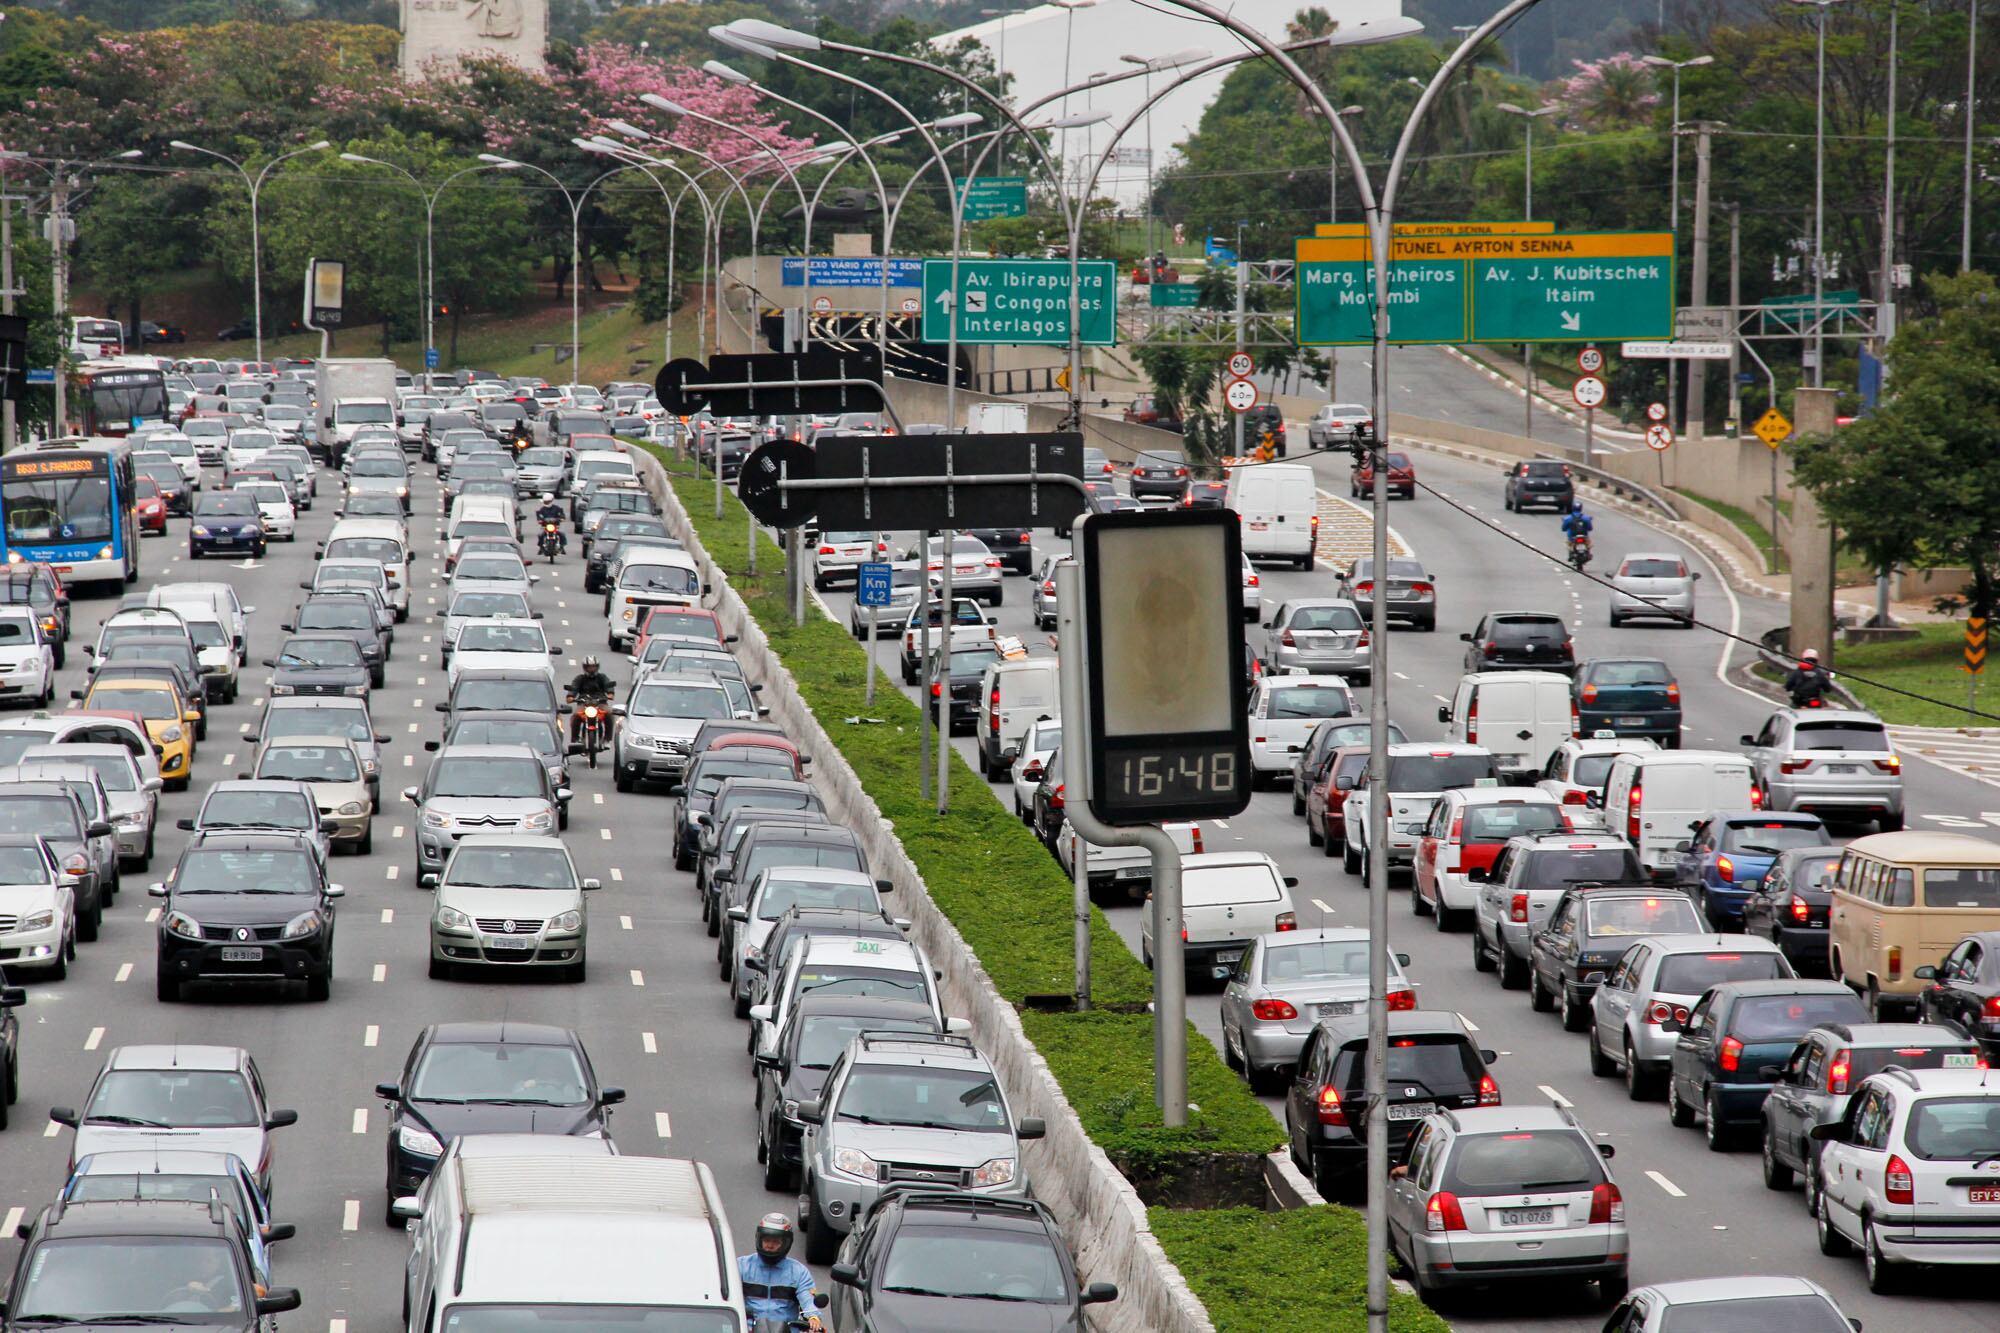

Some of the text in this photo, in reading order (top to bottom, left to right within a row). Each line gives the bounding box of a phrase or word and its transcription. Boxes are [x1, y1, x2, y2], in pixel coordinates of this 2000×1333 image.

[1415, 226, 1454, 234] AYRTON
[1458, 226, 1492, 234] SENNA
[1453, 241, 1514, 253] AYRTON
[1520, 240, 1574, 252] SENNA
[900, 262, 921, 270] SENN
[1306, 267, 1456, 288] Marg. Pnheiros
[1485, 264, 1660, 281] Av. J. Kubitschek
[966, 271, 992, 287] Av.
[1340, 288, 1420, 305] Mormbi
[1547, 287, 1595, 302] Itaim
[994, 294, 1102, 313] Congonas
[965, 317, 1066, 336] Interlagos
[1233, 357, 1249, 368] 60
[1582, 353, 1600, 364] 60
[865, 577, 887, 588] Km
[866, 591, 886, 603] 4,2
[857, 942, 880, 953] TAXI
[1948, 1056, 1975, 1065] TAXI
